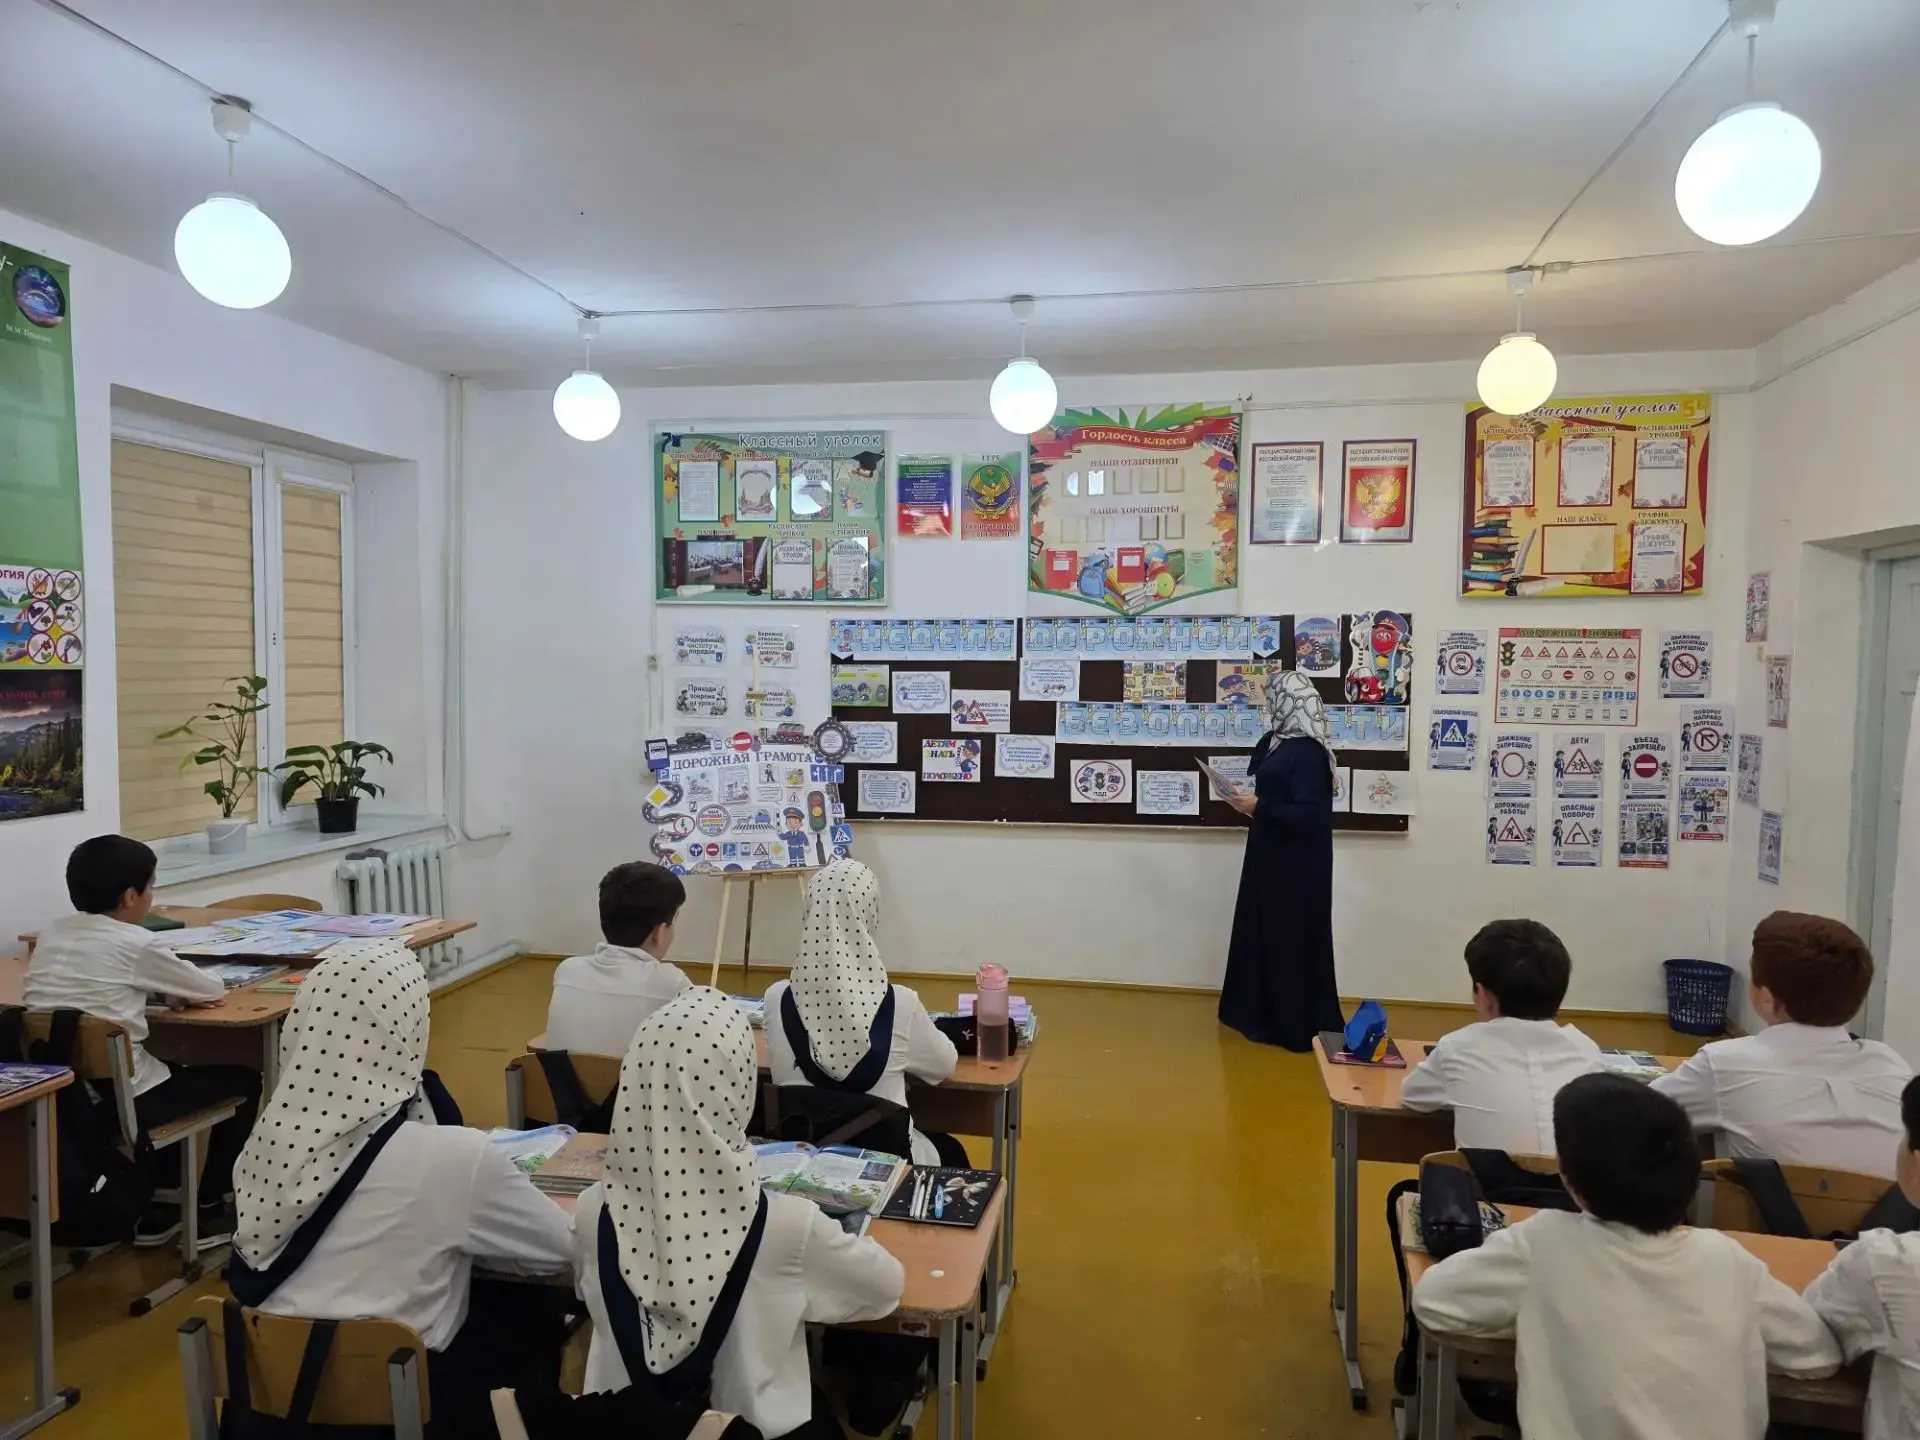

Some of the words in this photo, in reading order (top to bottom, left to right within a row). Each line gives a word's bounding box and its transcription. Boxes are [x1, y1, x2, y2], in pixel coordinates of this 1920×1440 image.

[1615, 401, 1679, 421] уголок
[739, 433, 818, 448] Классный
[823, 433, 881, 450] уголок
[1082, 429, 1141, 444] Гордость
[1143, 437, 1187, 446] класса
[1121, 457, 1179, 466] ОТЛИЧНИКИ
[1120, 505, 1180, 514] ХОРОШИСТЫ
[860, 627, 1012, 651] НЕДЕЛЯ
[687, 684, 717, 692] Приходи
[1065, 709, 1404, 740] БЕЗОПАССТИ
[1570, 737, 1590, 745] ДЕТИ
[1634, 736, 1659, 744] ВЪЕЗД
[1496, 741, 1533, 750] ЗАПРЕЩЕНО
[755, 751, 813, 763] ГРАМОТА
[672, 753, 751, 771] ДОРОЖНАЯ
[1560, 803, 1596, 811] ОПАСНЫЙ
[1562, 811, 1596, 819] ПОВОРОТ
